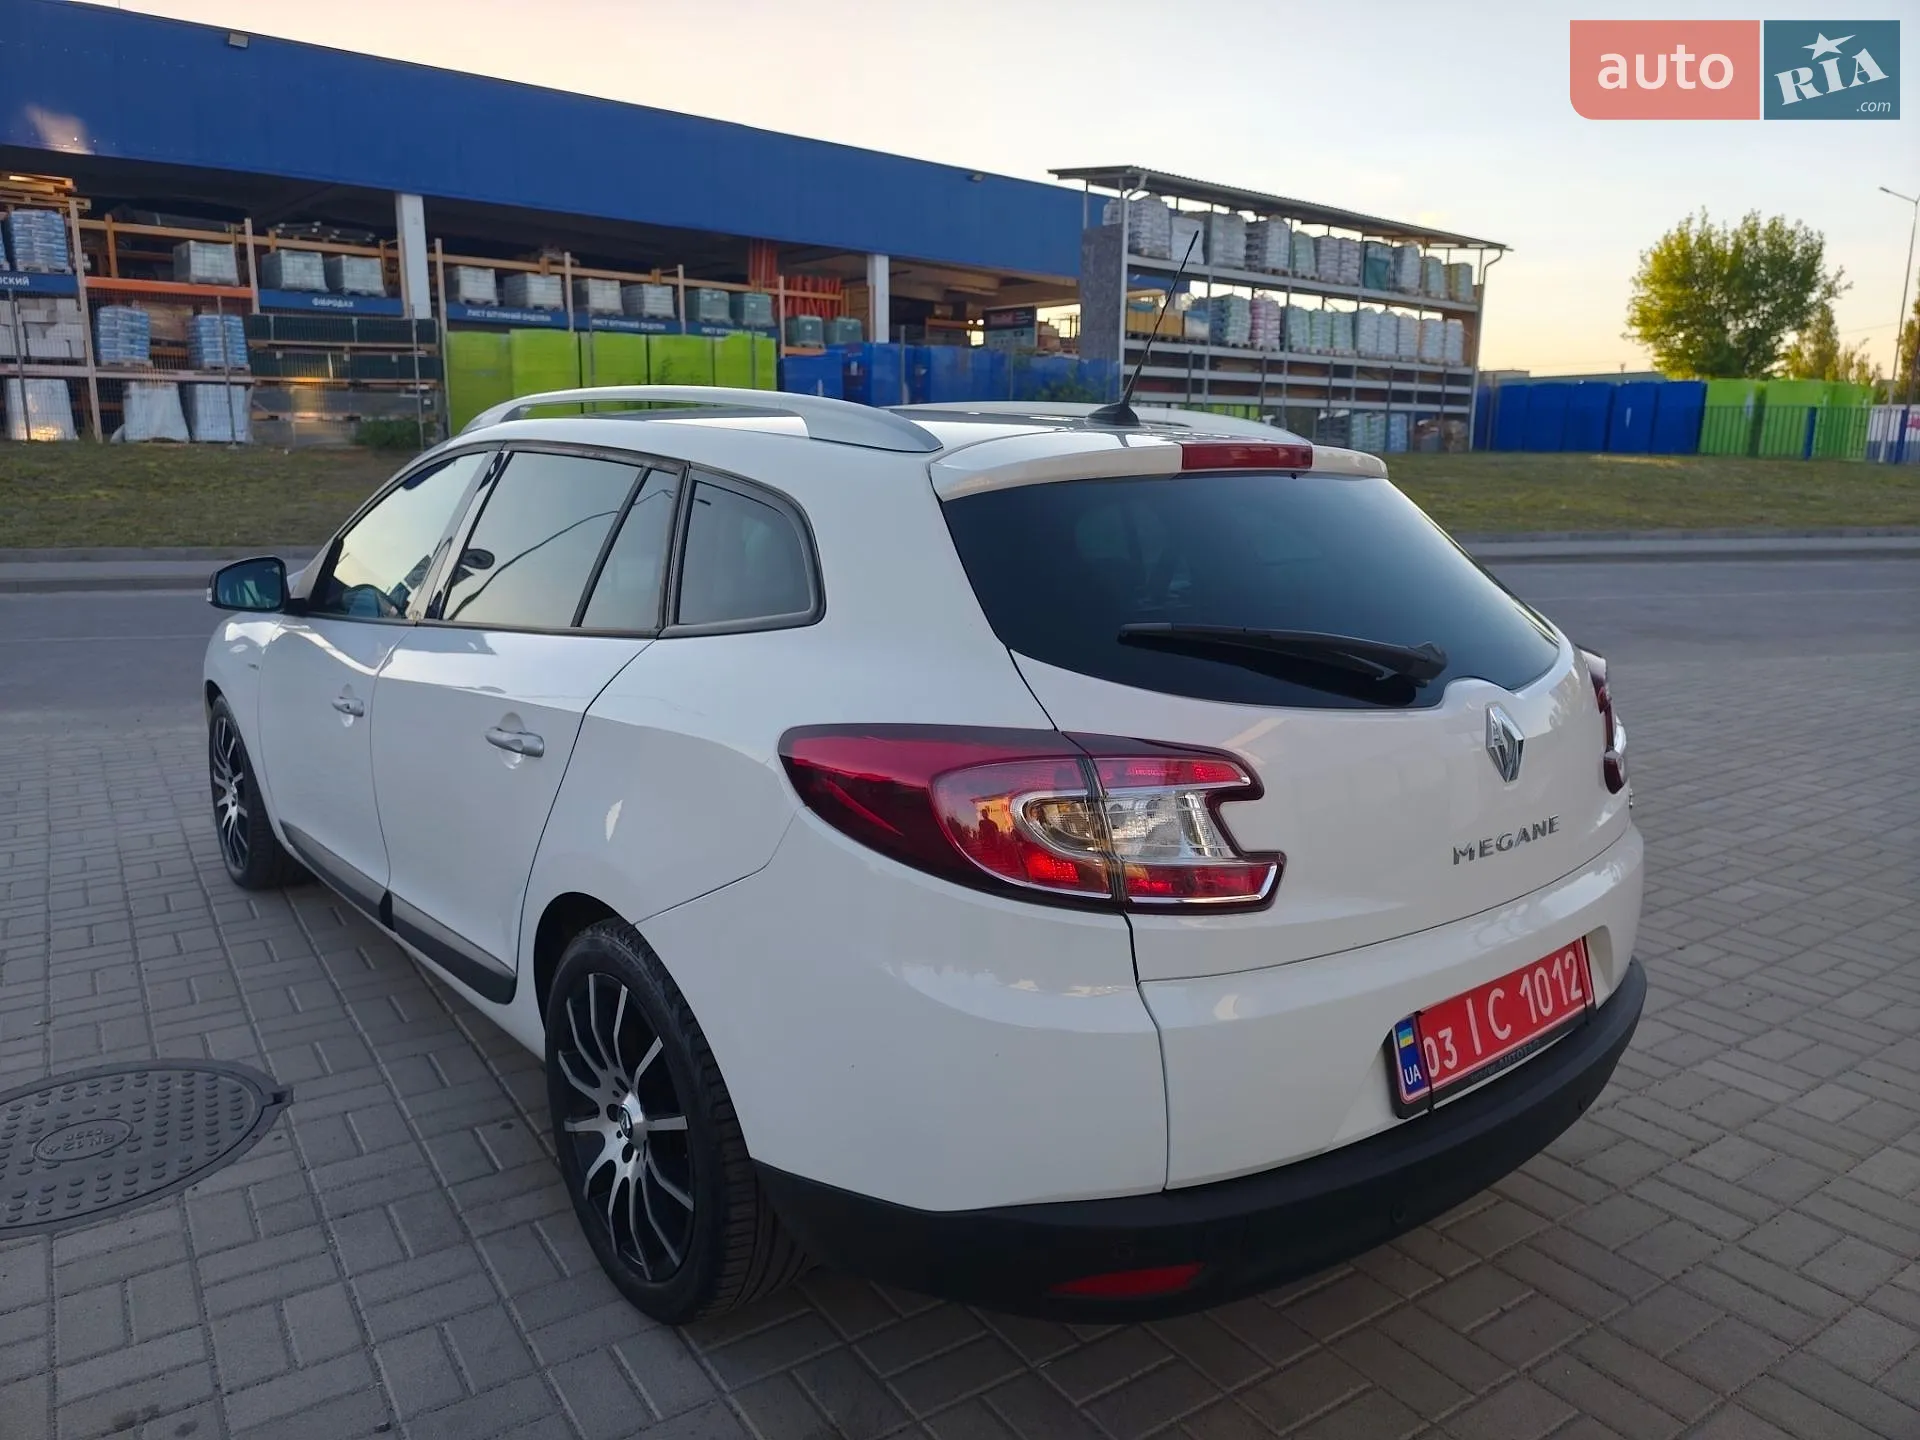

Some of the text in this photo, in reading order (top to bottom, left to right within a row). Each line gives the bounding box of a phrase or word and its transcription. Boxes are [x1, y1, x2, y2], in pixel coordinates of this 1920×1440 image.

[1452, 814, 1560, 866] MEGANE
[1423, 1027, 1459, 1078] 03
[1519, 950, 1583, 1024] 1012
[1404, 1063, 1422, 1086] UA
